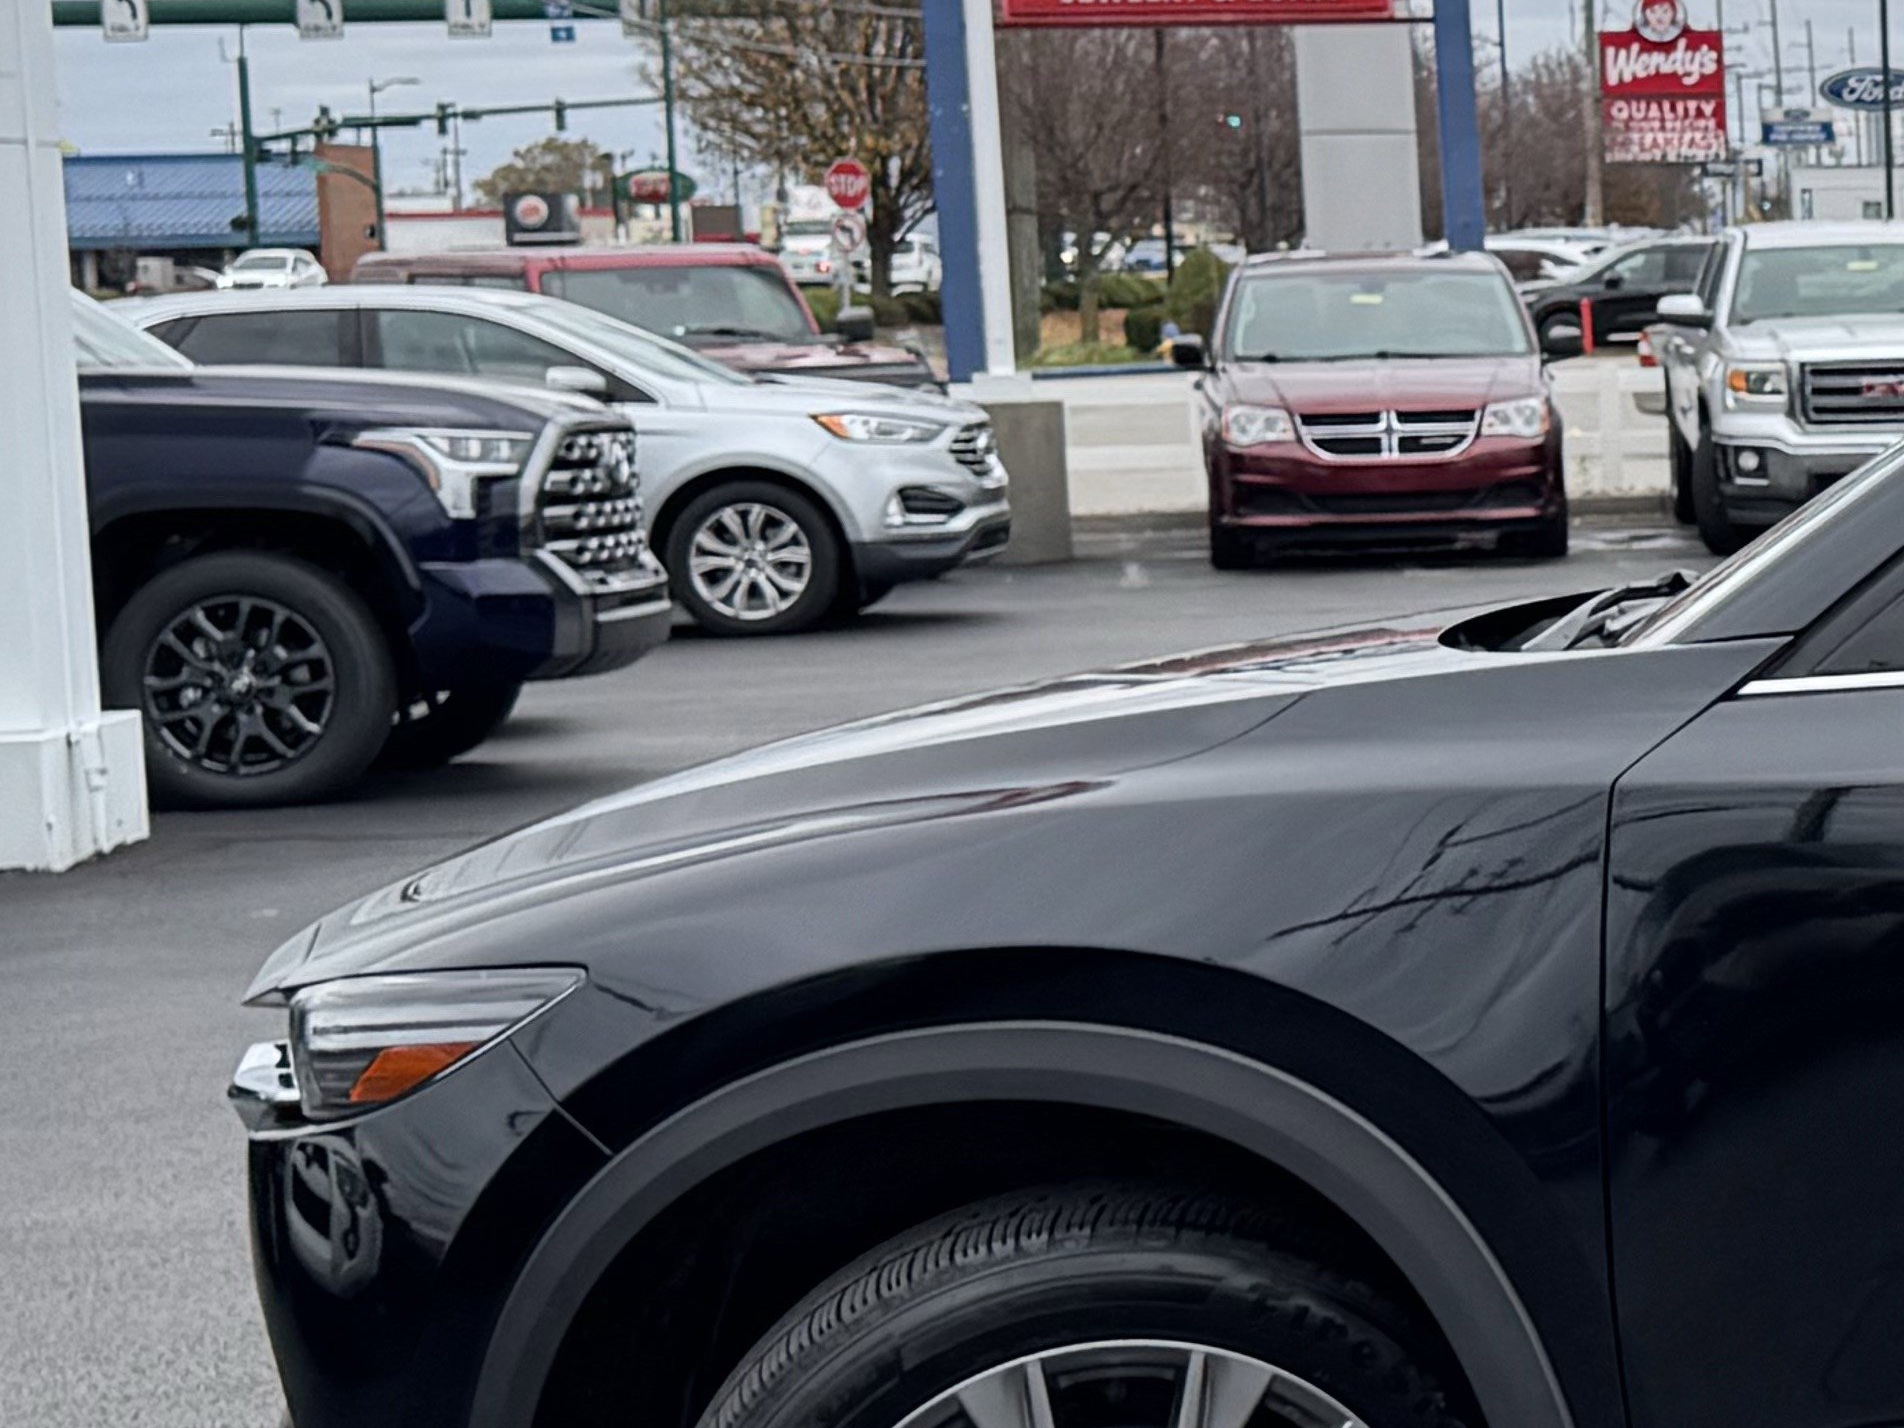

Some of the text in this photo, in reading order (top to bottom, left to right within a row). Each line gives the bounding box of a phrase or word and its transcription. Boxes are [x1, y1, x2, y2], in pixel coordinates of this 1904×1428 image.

[1604, 37, 1718, 86] Wendy's
[1610, 99, 1716, 121] QUALITY
[830, 173, 866, 197] STOP
